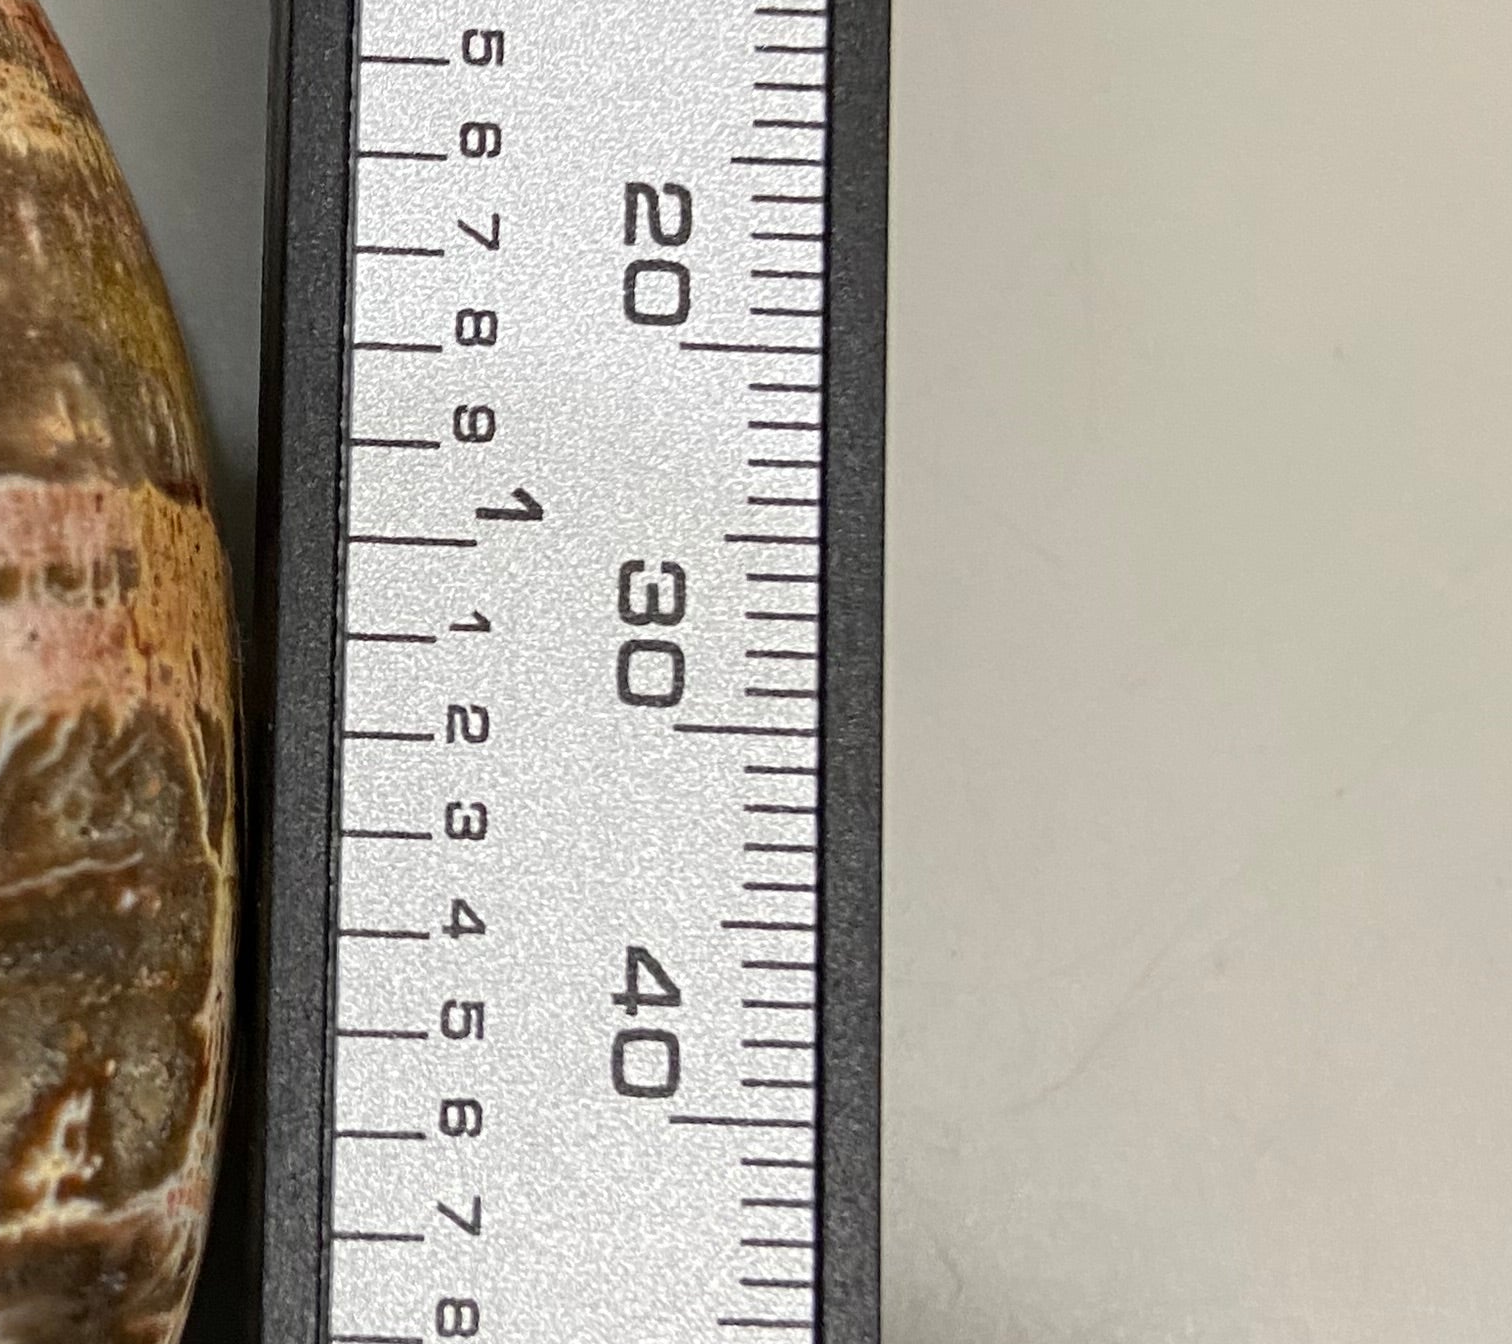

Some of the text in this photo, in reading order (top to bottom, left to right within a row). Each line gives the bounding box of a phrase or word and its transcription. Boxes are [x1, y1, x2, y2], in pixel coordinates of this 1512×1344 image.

[459, 26, 507, 69] 5
[457, 119, 504, 161] 6
[455, 211, 503, 253] 7
[621, 180, 695, 329] 20
[452, 306, 500, 349] 8
[451, 402, 499, 446] 9
[473, 485, 547, 524] 1
[447, 608, 494, 635] 1
[614, 557, 689, 711] 30
[444, 702, 492, 746] 2
[442, 799, 491, 843] 3
[440, 896, 489, 942] 4
[438, 997, 487, 1042] 5
[609, 943, 684, 1101] 40
[436, 1096, 485, 1140] 6
[434, 1194, 484, 1239] 7
[433, 1295, 482, 1341] 8
